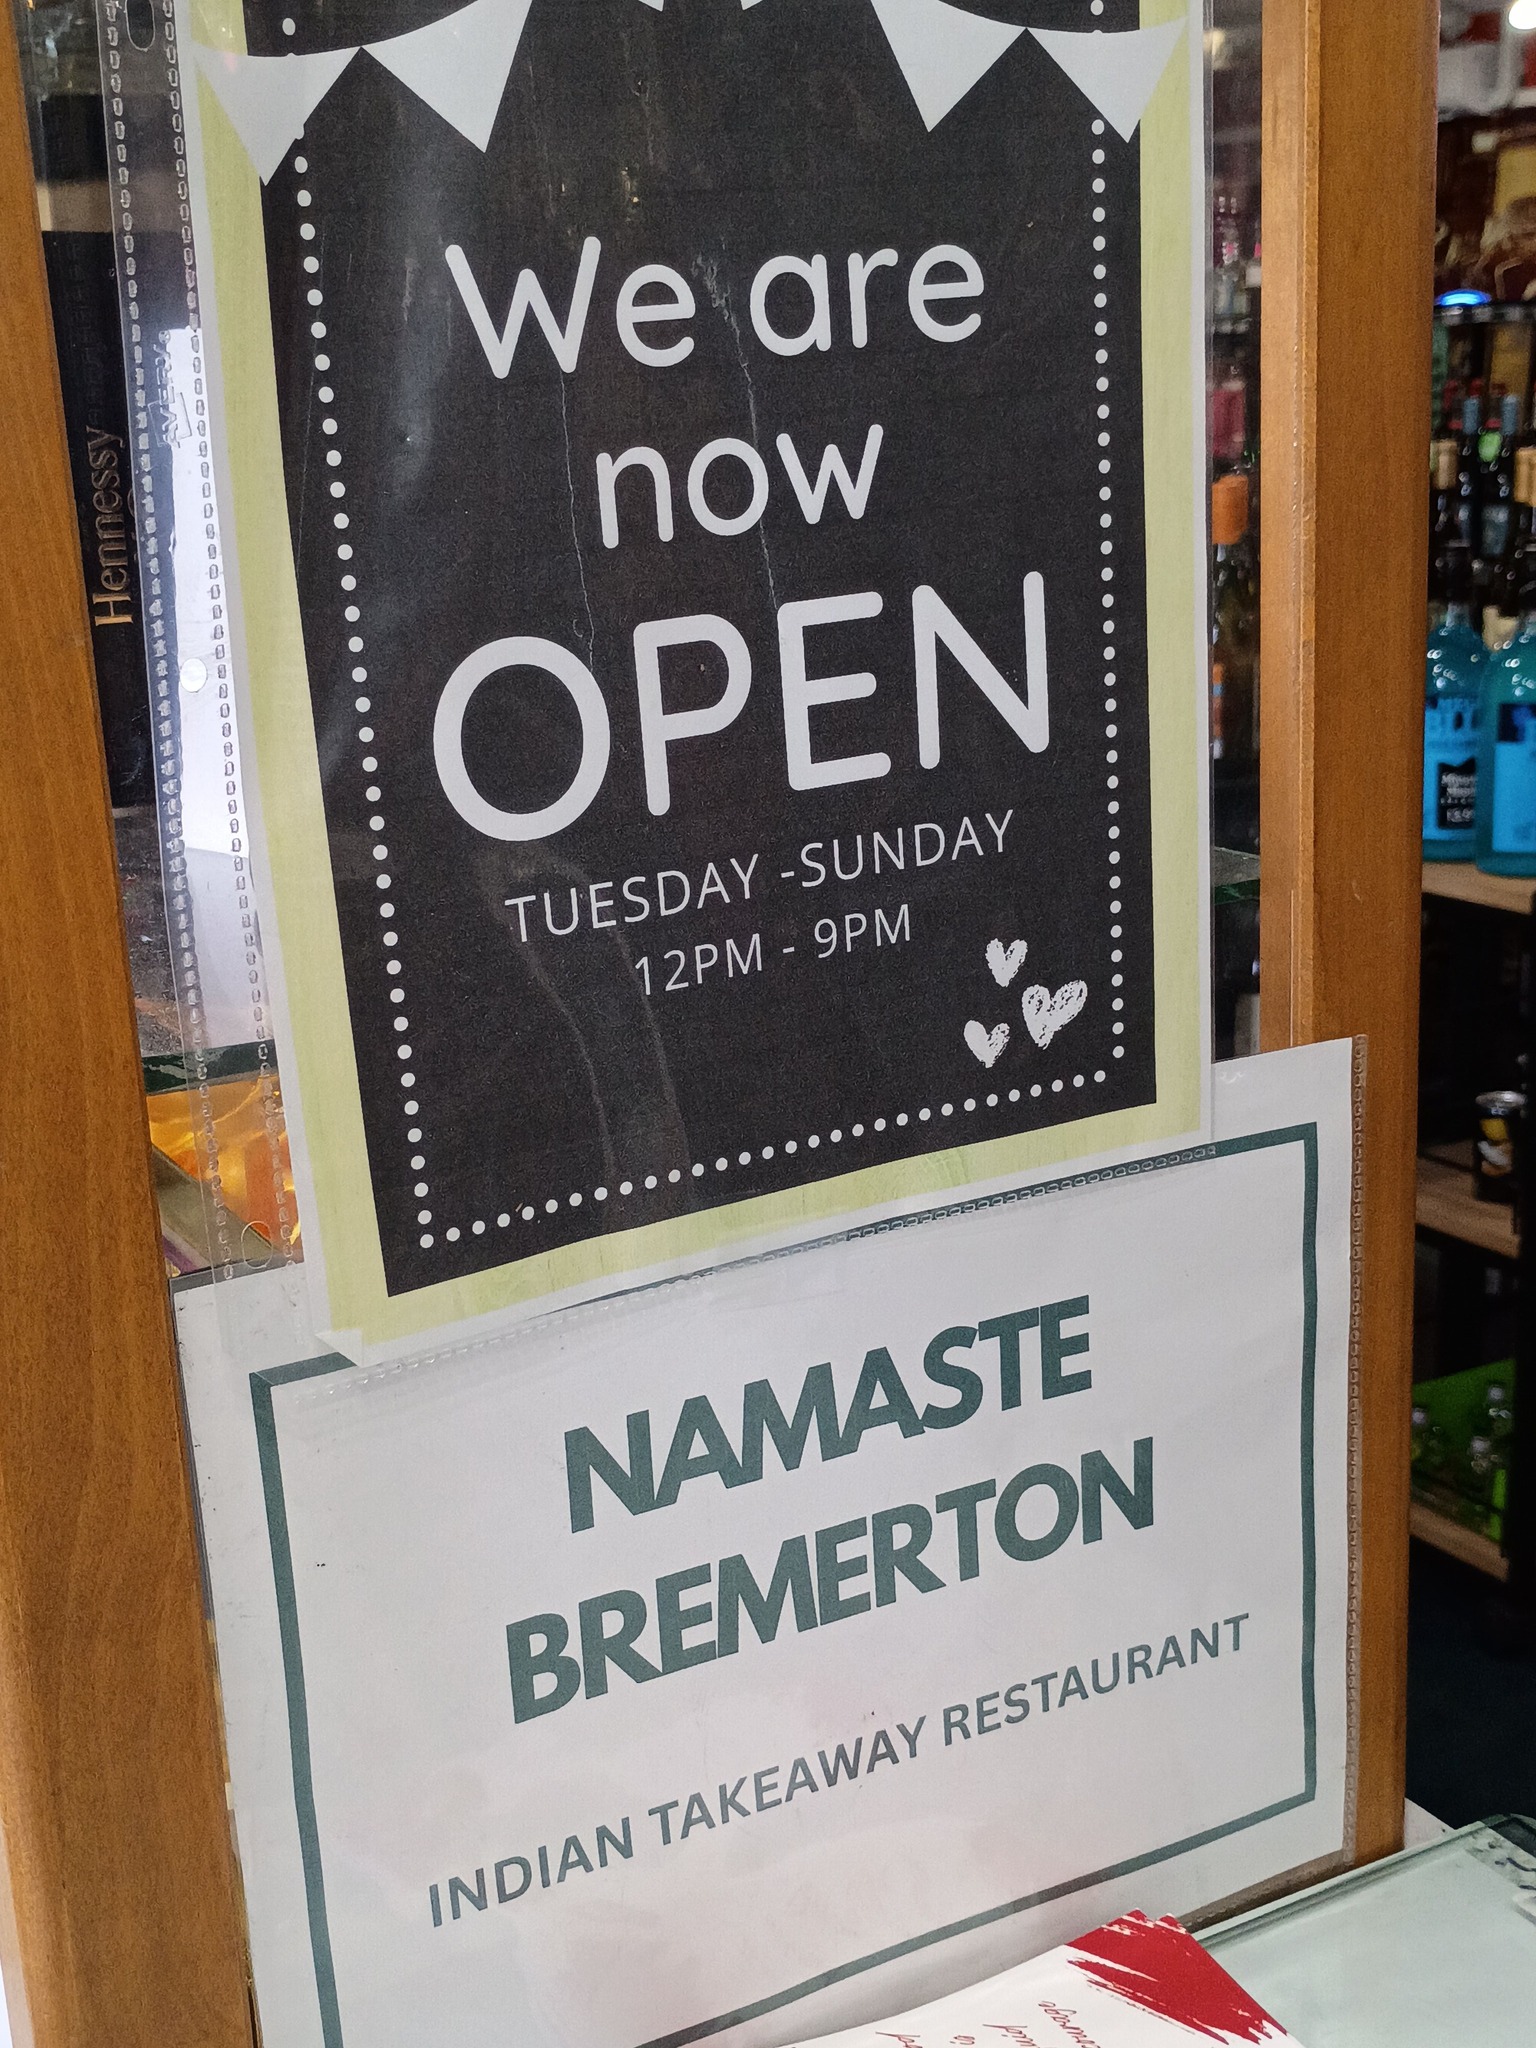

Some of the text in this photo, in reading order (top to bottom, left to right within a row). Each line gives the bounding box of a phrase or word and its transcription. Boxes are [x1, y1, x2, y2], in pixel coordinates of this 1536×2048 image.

[445, 236, 984, 379] We are
[86, 426, 133, 626] Hennessy
[596, 424, 883, 548] now
[433, 571, 1049, 841] OPEN
[505, 854, 758, 942] TUESDAY
[635, 933, 763, 996] 12PM
[814, 904, 911, 959] 9PM
[564, 1295, 1093, 1534] NAMASTE
[505, 1437, 1154, 1725] BREMERTON
[428, 1614, 1251, 1928] INDIAN TAKEAWAY RESTAURANT
